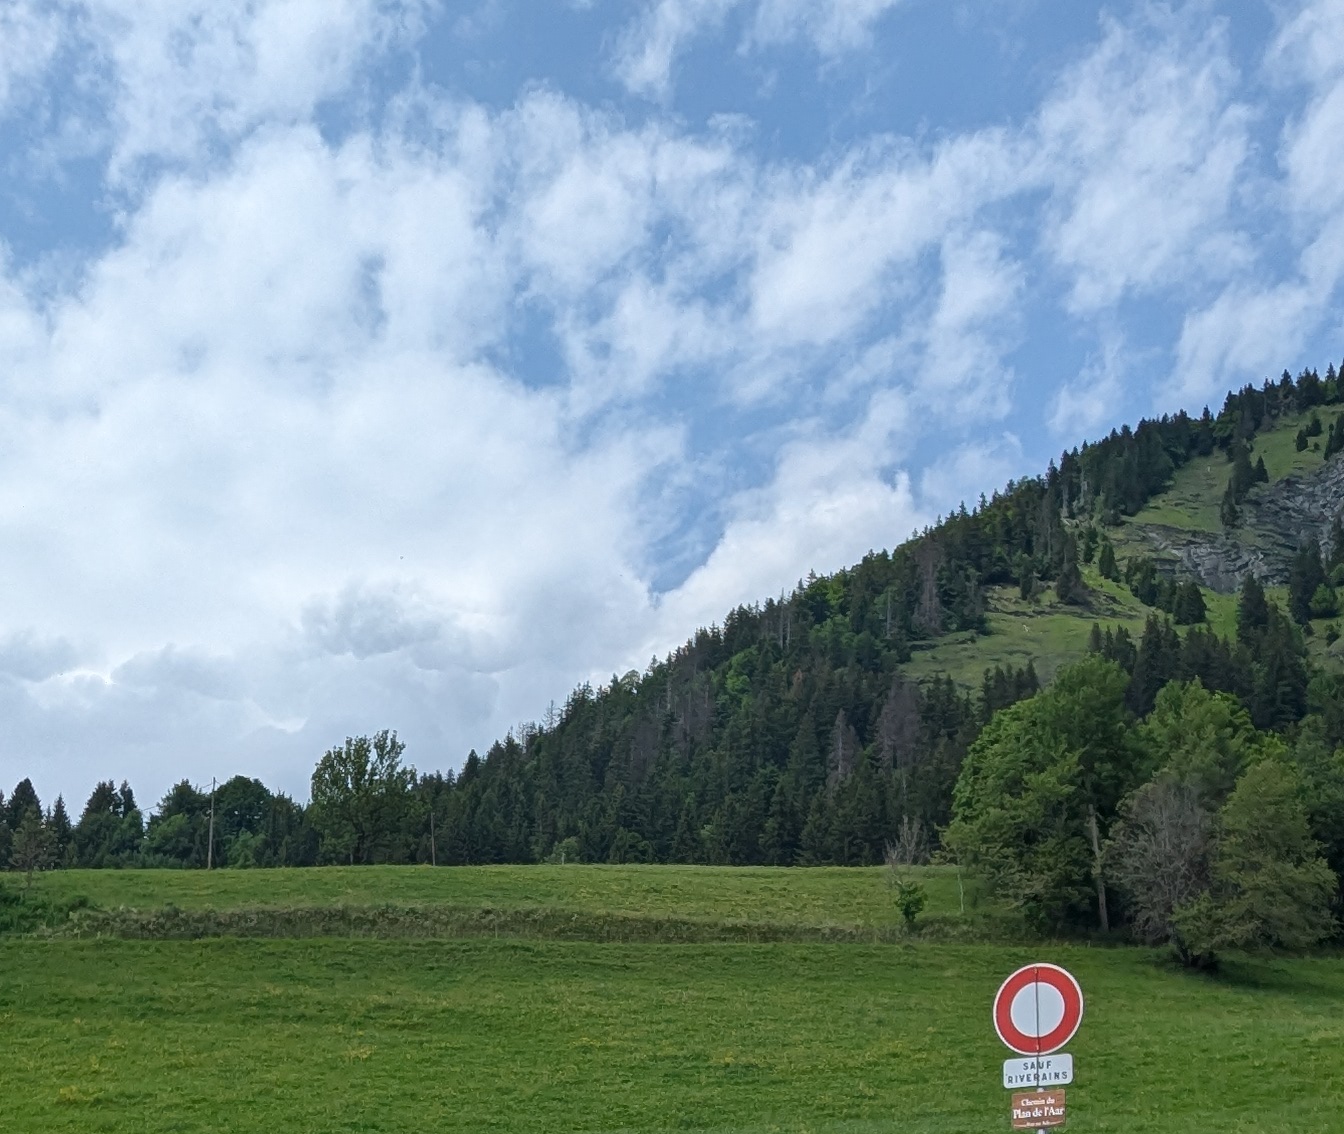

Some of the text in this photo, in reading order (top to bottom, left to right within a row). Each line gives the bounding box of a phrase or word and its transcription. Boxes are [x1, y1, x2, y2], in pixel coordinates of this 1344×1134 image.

[1023, 1060, 1052, 1070] SAUF
[1007, 1071, 1068, 1083] RIVERAINS
[1013, 1109, 1031, 1119] Plan
[1032, 1107, 1042, 1117] de
